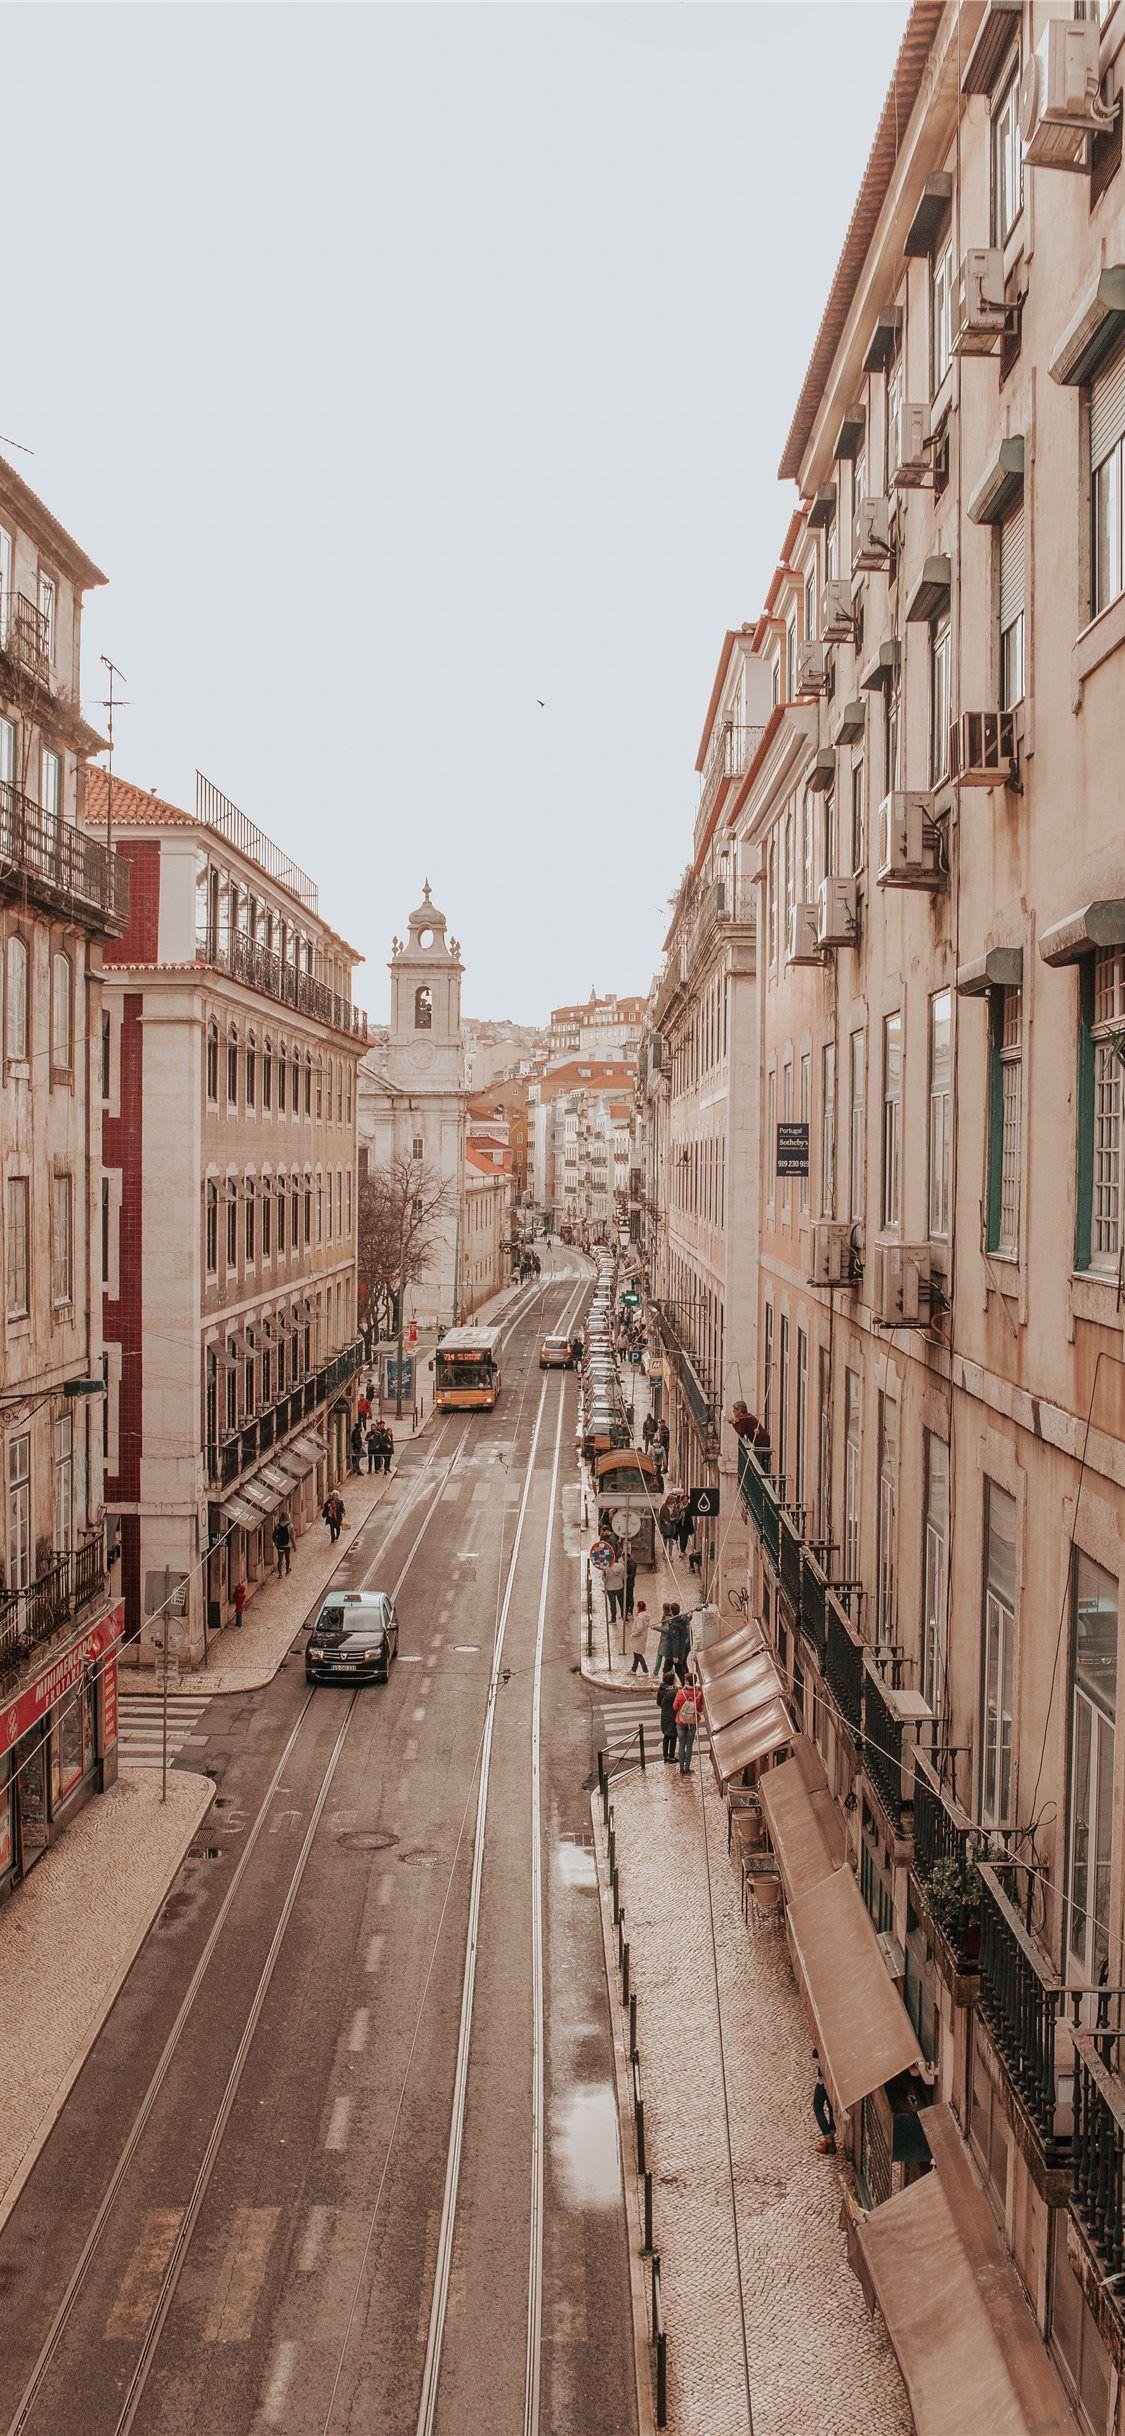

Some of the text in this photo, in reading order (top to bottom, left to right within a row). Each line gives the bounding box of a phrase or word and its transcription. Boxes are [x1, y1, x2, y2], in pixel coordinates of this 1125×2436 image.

[779, 1127, 802, 1135] Portugal
[779, 1138, 808, 1147] Sotheby's
[777, 1160, 787, 1168] 919
[787, 1160, 800, 1168] 230
[35, 1634, 94, 1704] MINIMERCADO
